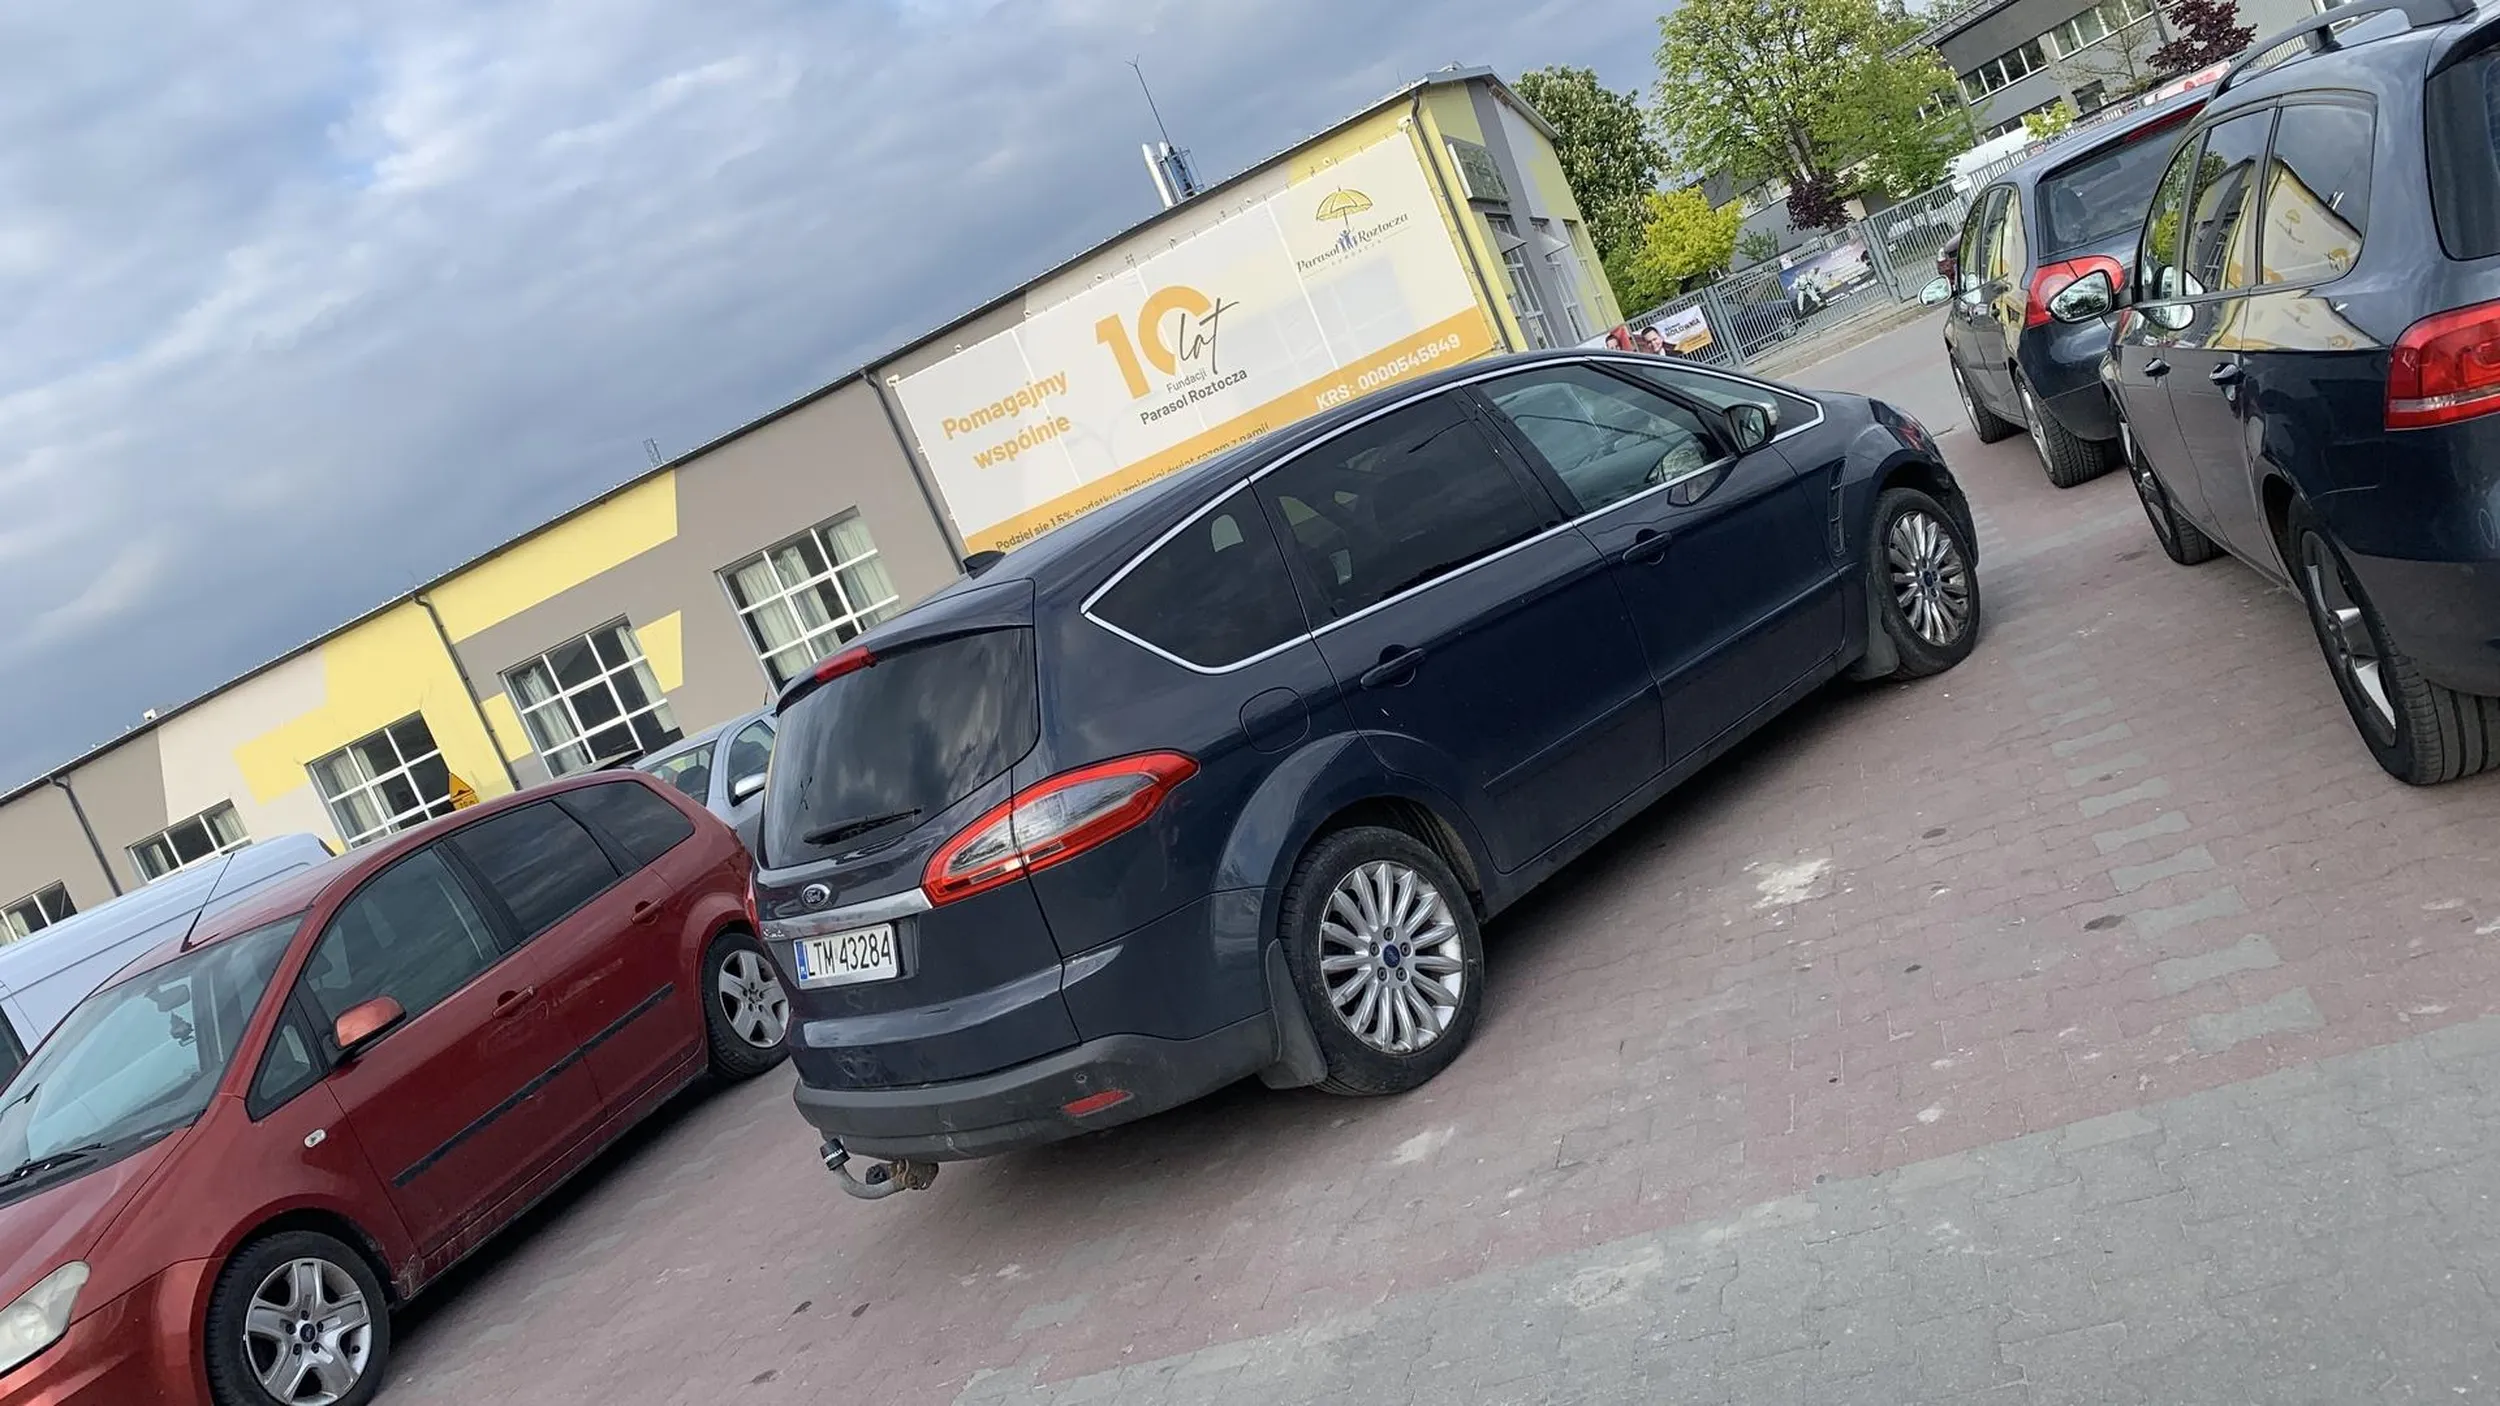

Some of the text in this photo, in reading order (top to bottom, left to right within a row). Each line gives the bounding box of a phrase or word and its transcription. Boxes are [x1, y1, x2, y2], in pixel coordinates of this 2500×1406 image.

[1296, 212, 1409, 272] Parasol Roztocza
[1094, 284, 1212, 400] 10
[1178, 297, 1240, 376] lat
[1140, 366, 1249, 426] Parasol Roztocza
[1166, 367, 1208, 394] Fundacji
[1315, 332, 1461, 410] KRS: 0000545849
[942, 370, 1068, 440] Pomagajmy
[973, 414, 1071, 470] wspólnie
[995, 526, 1035, 551] Podziel
[804, 930, 892, 976] LTM 43284
